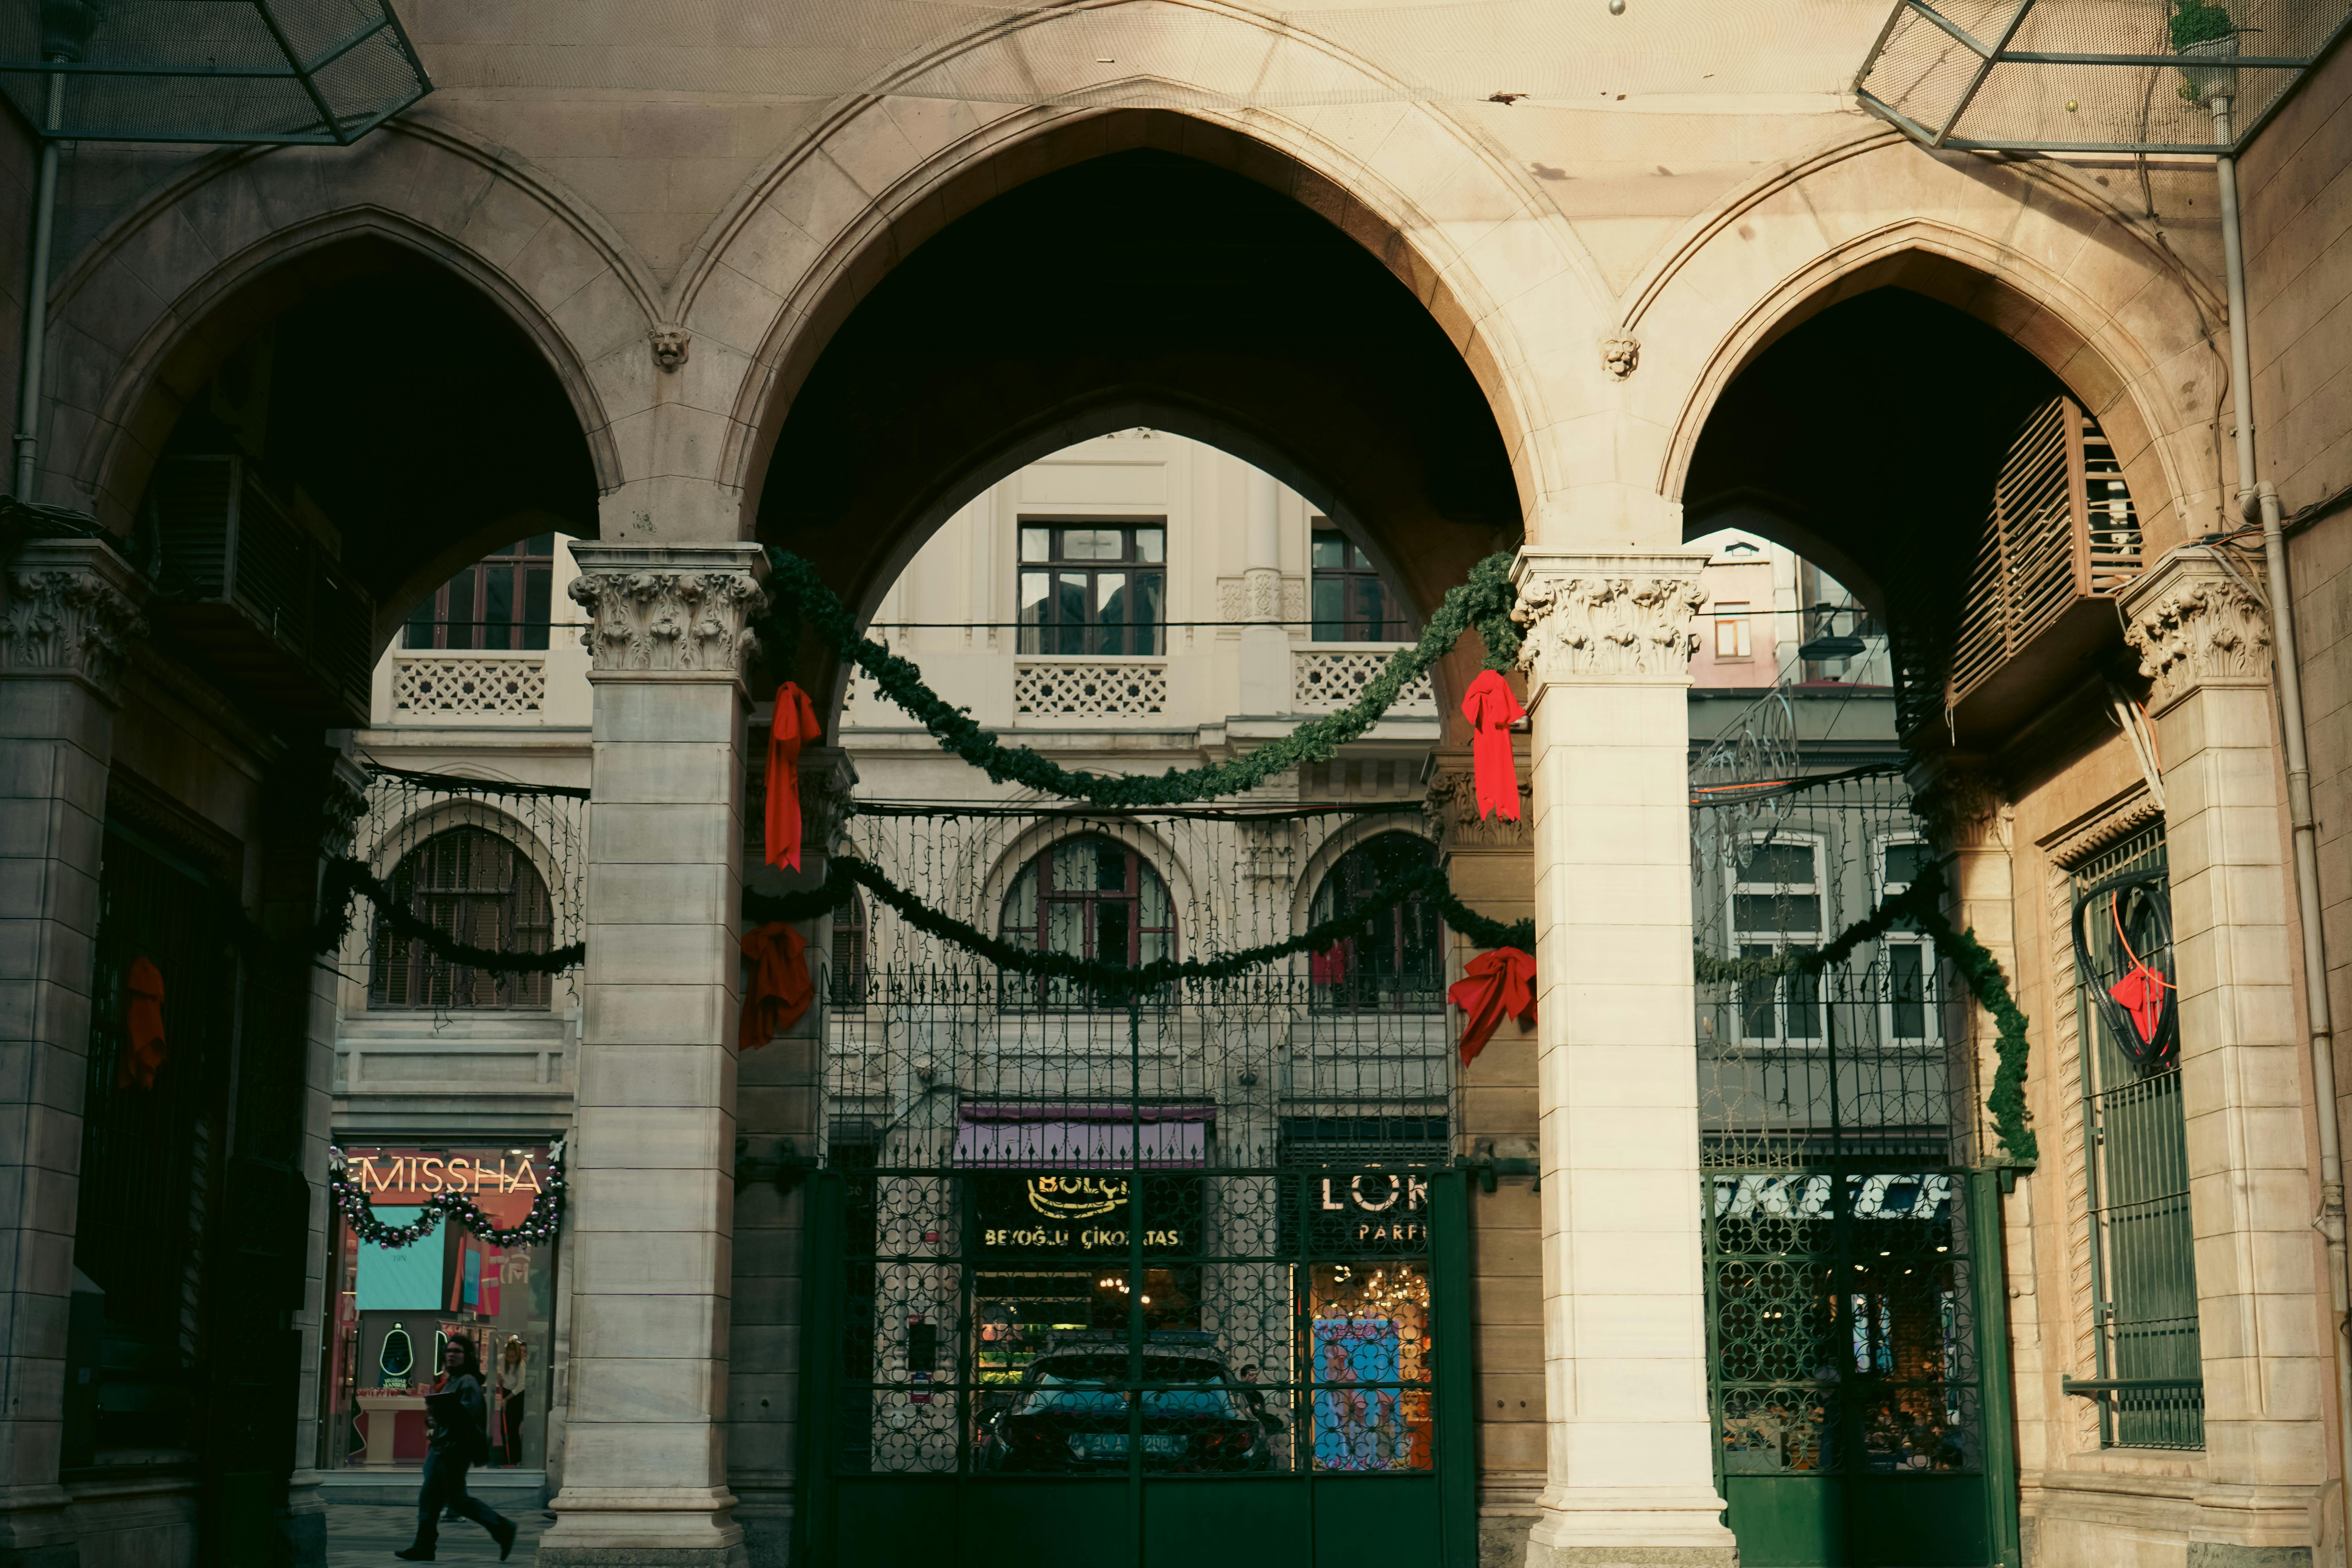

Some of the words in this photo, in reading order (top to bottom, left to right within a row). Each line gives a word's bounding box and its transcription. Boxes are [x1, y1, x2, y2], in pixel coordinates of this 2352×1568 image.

[361, 1157, 542, 1194] MISSHA
[1323, 1163, 1449, 1211] LOR
[1081, 1225, 1183, 1249] ÇİKOTAS
